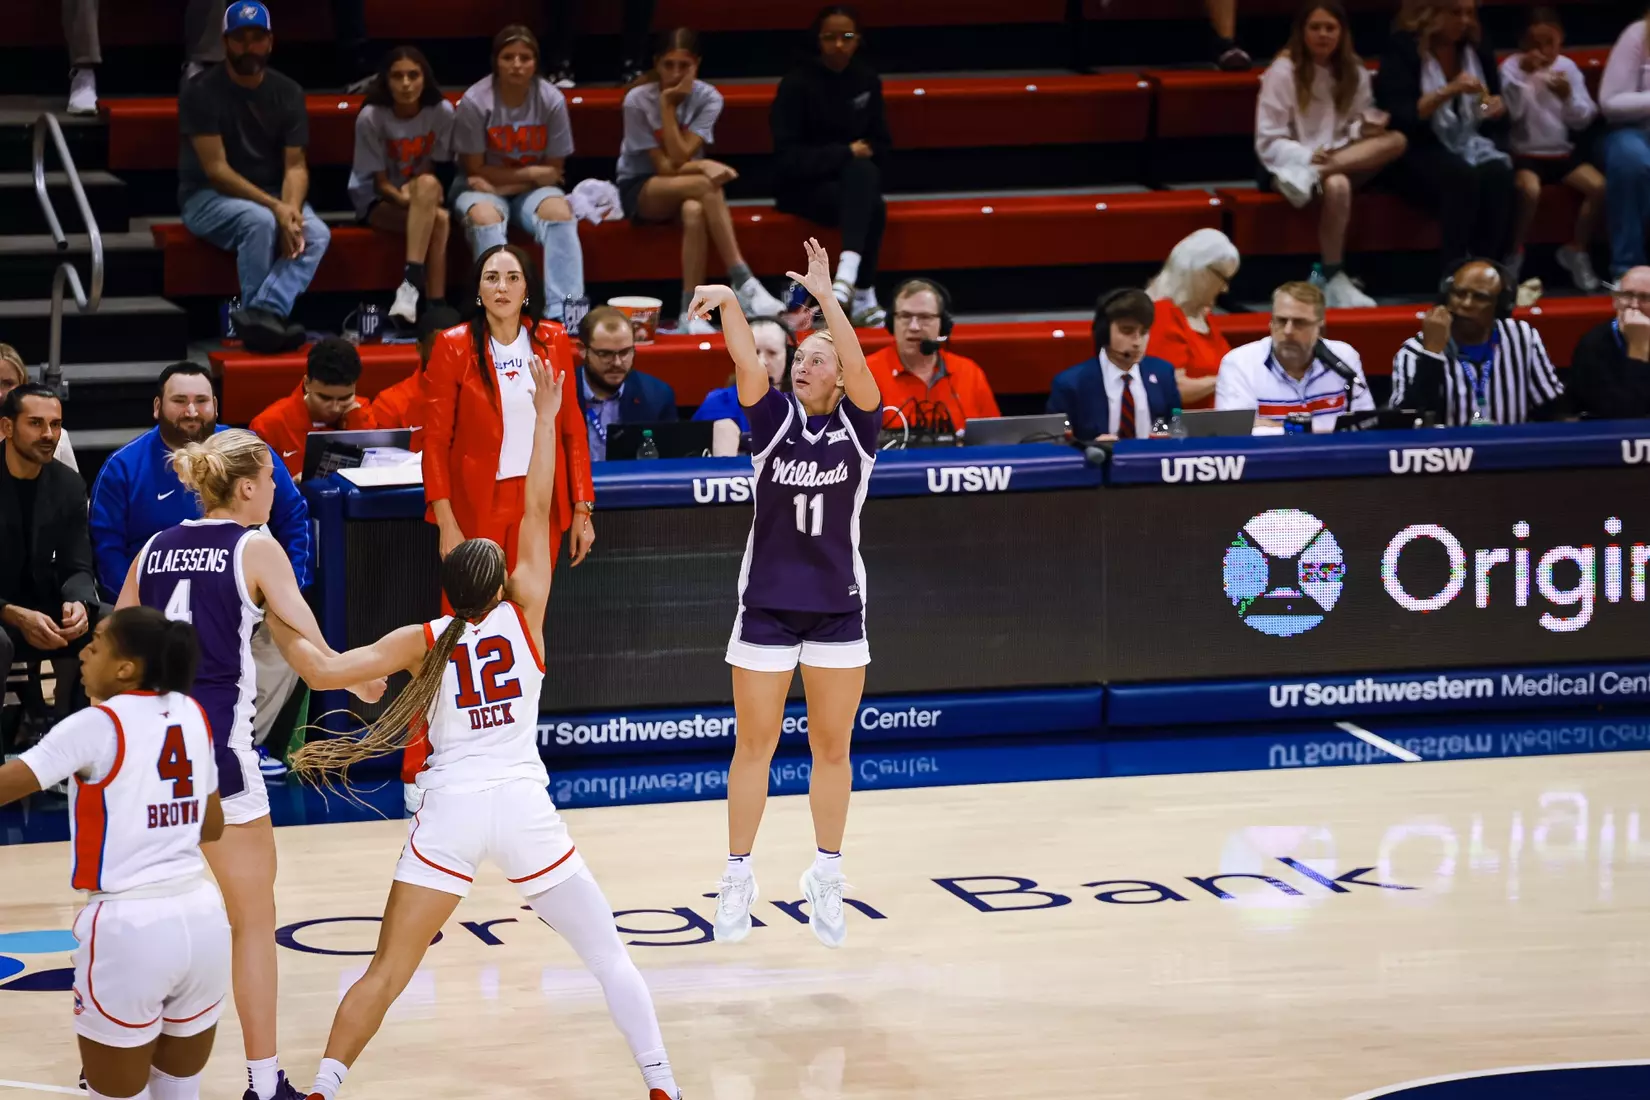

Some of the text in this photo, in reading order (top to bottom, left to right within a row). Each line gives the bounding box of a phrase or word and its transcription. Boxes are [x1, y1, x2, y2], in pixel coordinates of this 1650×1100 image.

[495, 358, 522, 369] SMU
[771, 456, 849, 488] Wildcats
[1161, 455, 1246, 483] UTSW
[1389, 447, 1473, 473] UTSW
[693, 476, 756, 504] UTS
[927, 466, 1012, 493] UTSW
[793, 493, 824, 537] 11
[147, 548, 229, 574] CLAESSENS
[164, 578, 193, 625] 4
[449, 634, 523, 709] 12
[1501, 672, 1595, 697] Medical
[468, 701, 516, 730] DECK
[536, 706, 942, 746] TSouthwester Center
[156, 723, 194, 799] 4
[931, 856, 1423, 913] Bank
